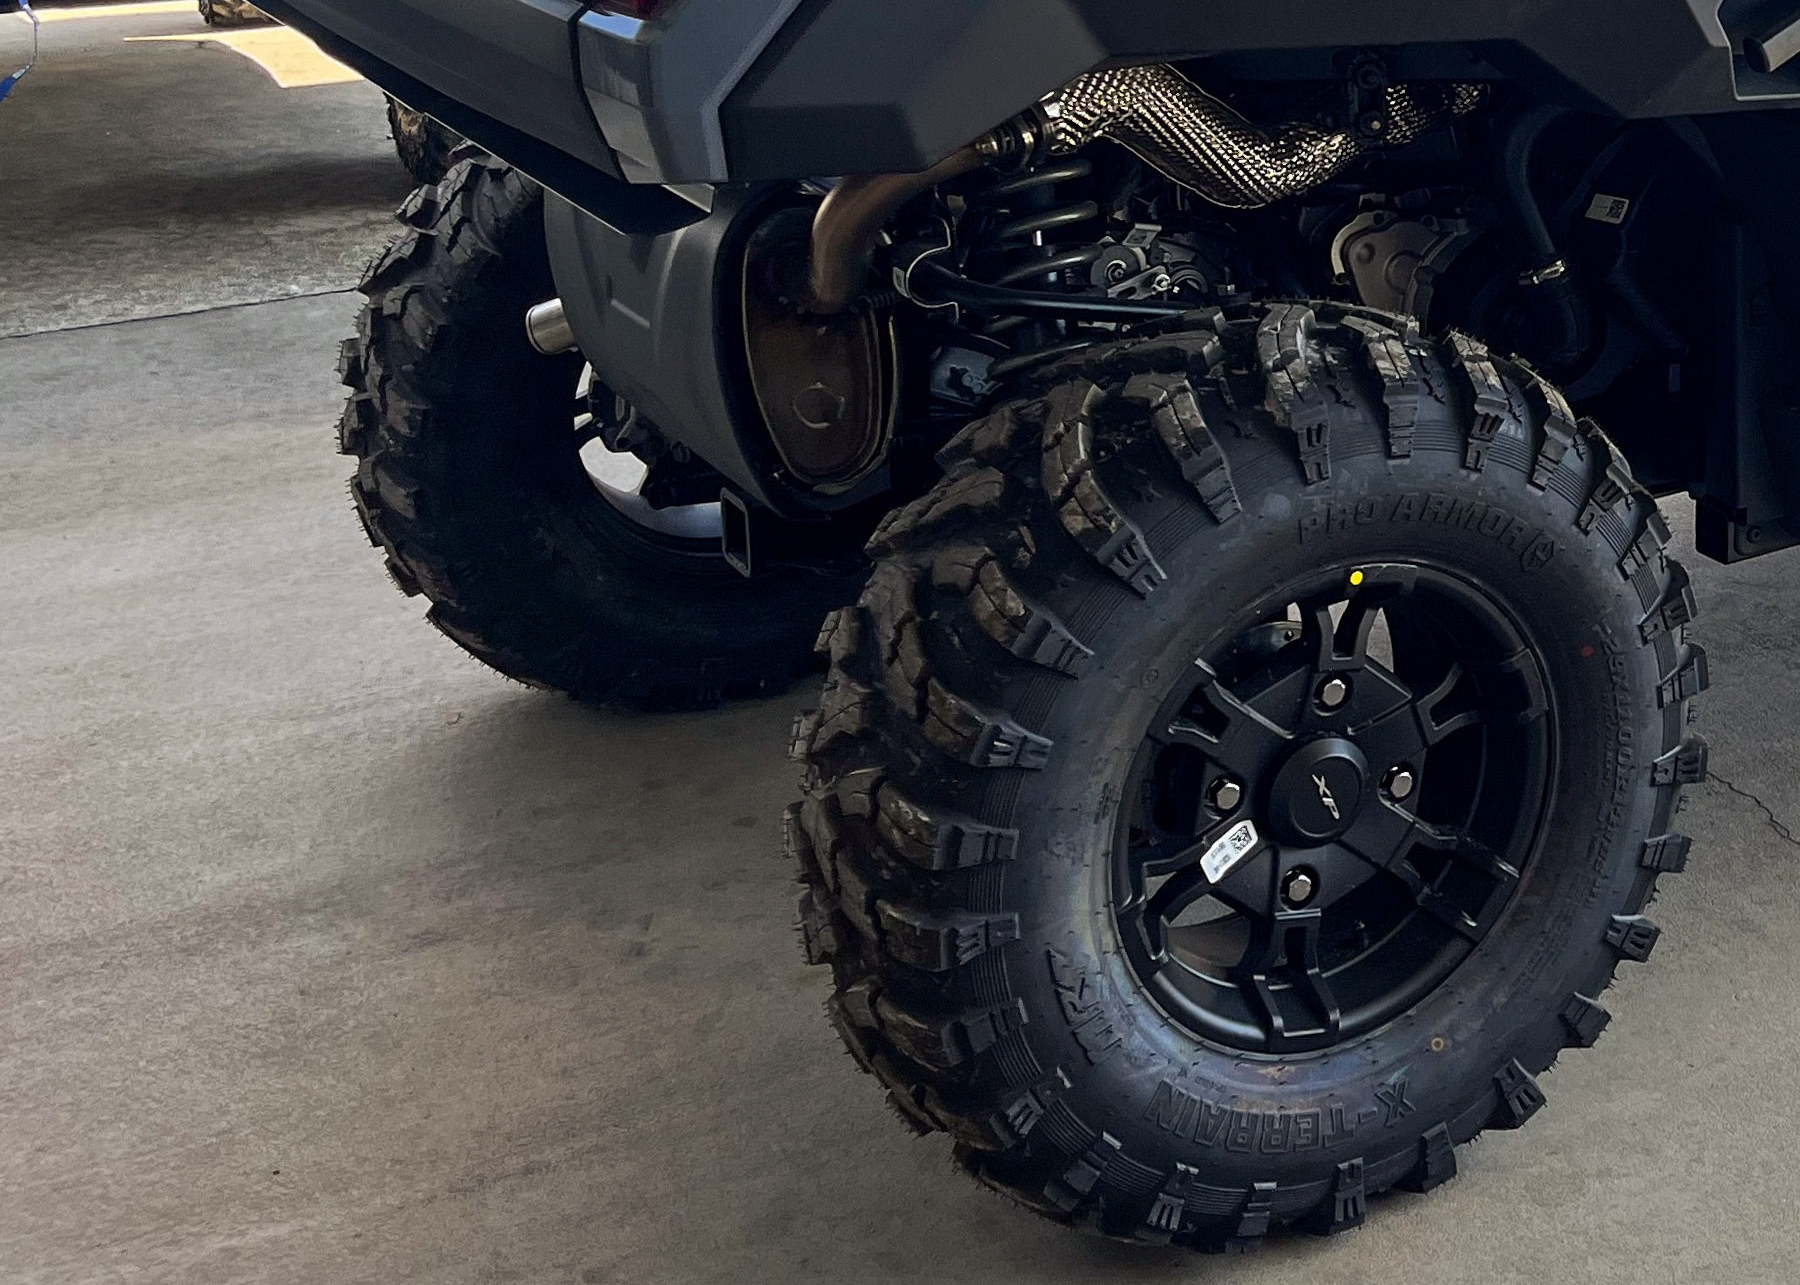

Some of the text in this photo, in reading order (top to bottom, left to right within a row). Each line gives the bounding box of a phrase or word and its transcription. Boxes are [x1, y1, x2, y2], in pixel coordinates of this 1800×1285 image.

[1390, 491, 1531, 550] ARMOR
[1311, 773, 1340, 821] XP
[1143, 1075, 1417, 1155] X-TERRAIN
